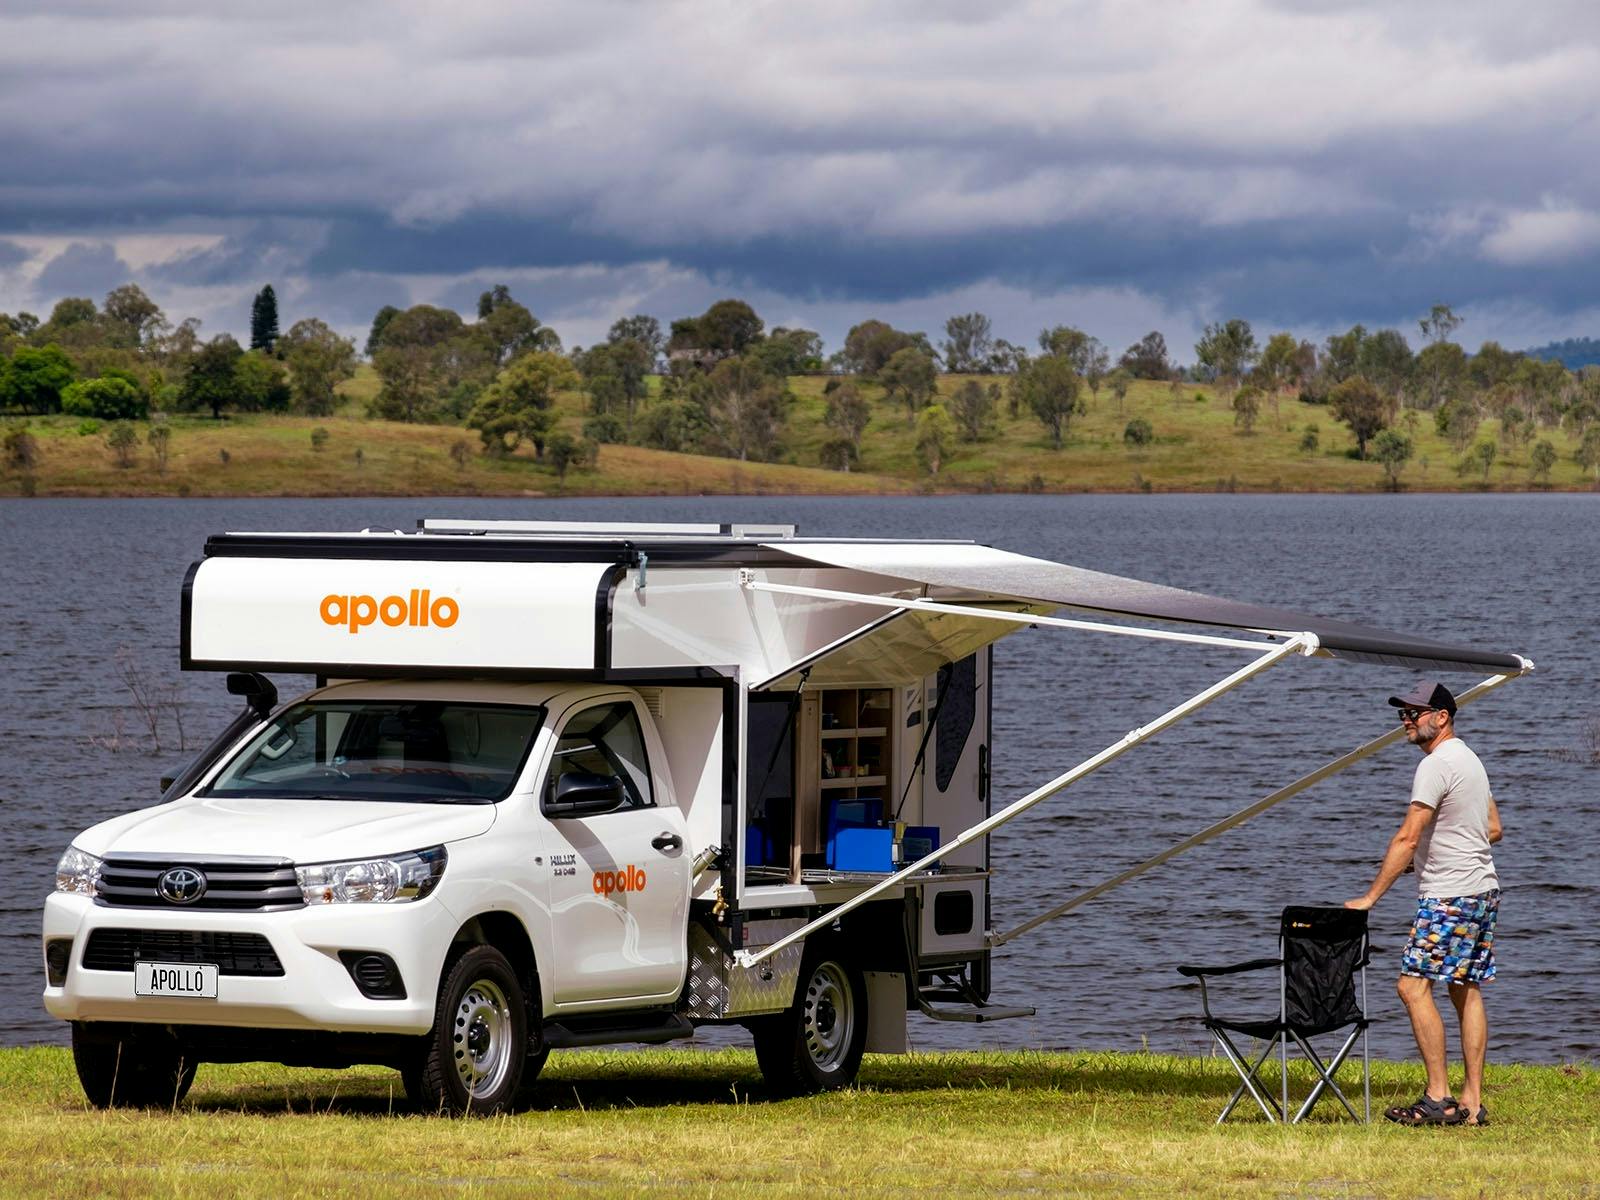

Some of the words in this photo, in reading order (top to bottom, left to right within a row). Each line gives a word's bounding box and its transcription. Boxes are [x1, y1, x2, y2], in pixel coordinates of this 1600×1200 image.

[319, 588, 460, 634] apollo
[593, 864, 646, 899] apollo
[150, 968, 203, 992] APOLLO
